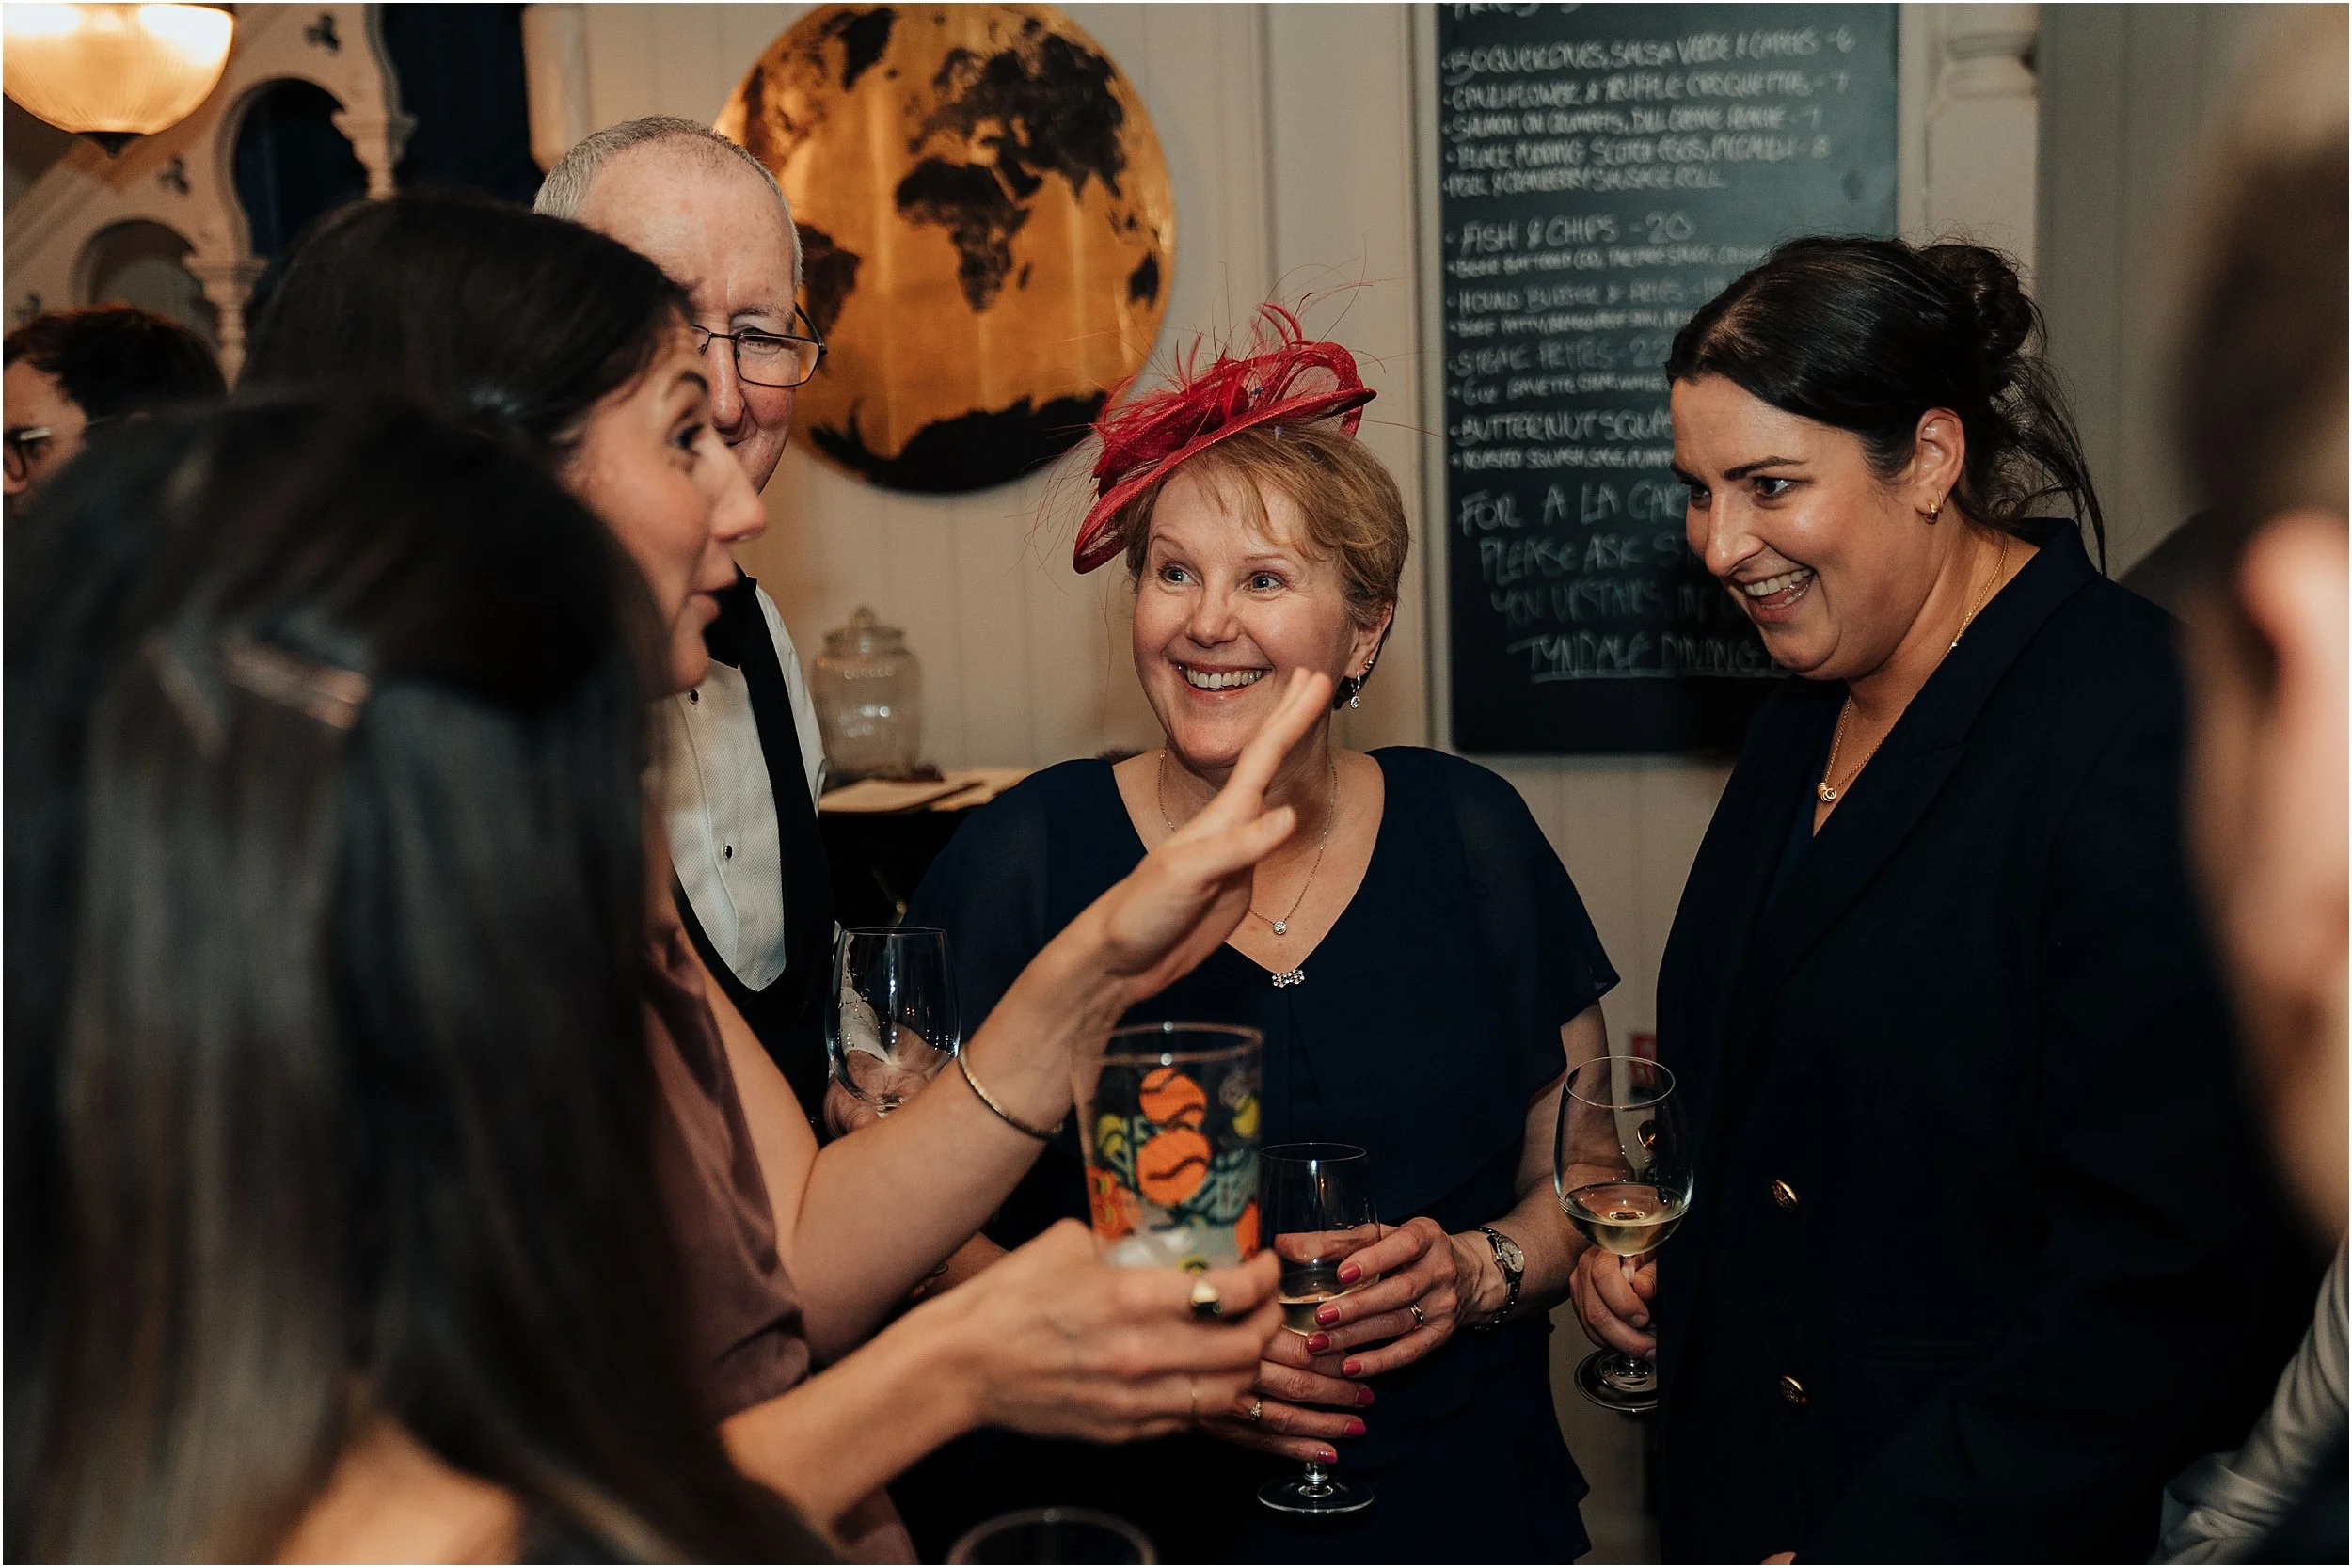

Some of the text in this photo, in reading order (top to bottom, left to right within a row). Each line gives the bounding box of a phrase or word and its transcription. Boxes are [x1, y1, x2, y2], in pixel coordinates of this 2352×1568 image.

[1610, 38, 1677, 68] SALSA
[1632, 103, 1666, 134] DILL
[1460, 219, 1519, 257] FISH
[1546, 213, 1620, 247] CHIPS
[1456, 409, 1600, 446] BUTTERNUT
[1460, 489, 1524, 537] FOR
[1541, 483, 1569, 526] A
[1581, 481, 1622, 525] LA
[1480, 536, 1578, 585] PLEASE
[1583, 532, 1645, 574] ASK
[1661, 629, 1763, 672] DINING
